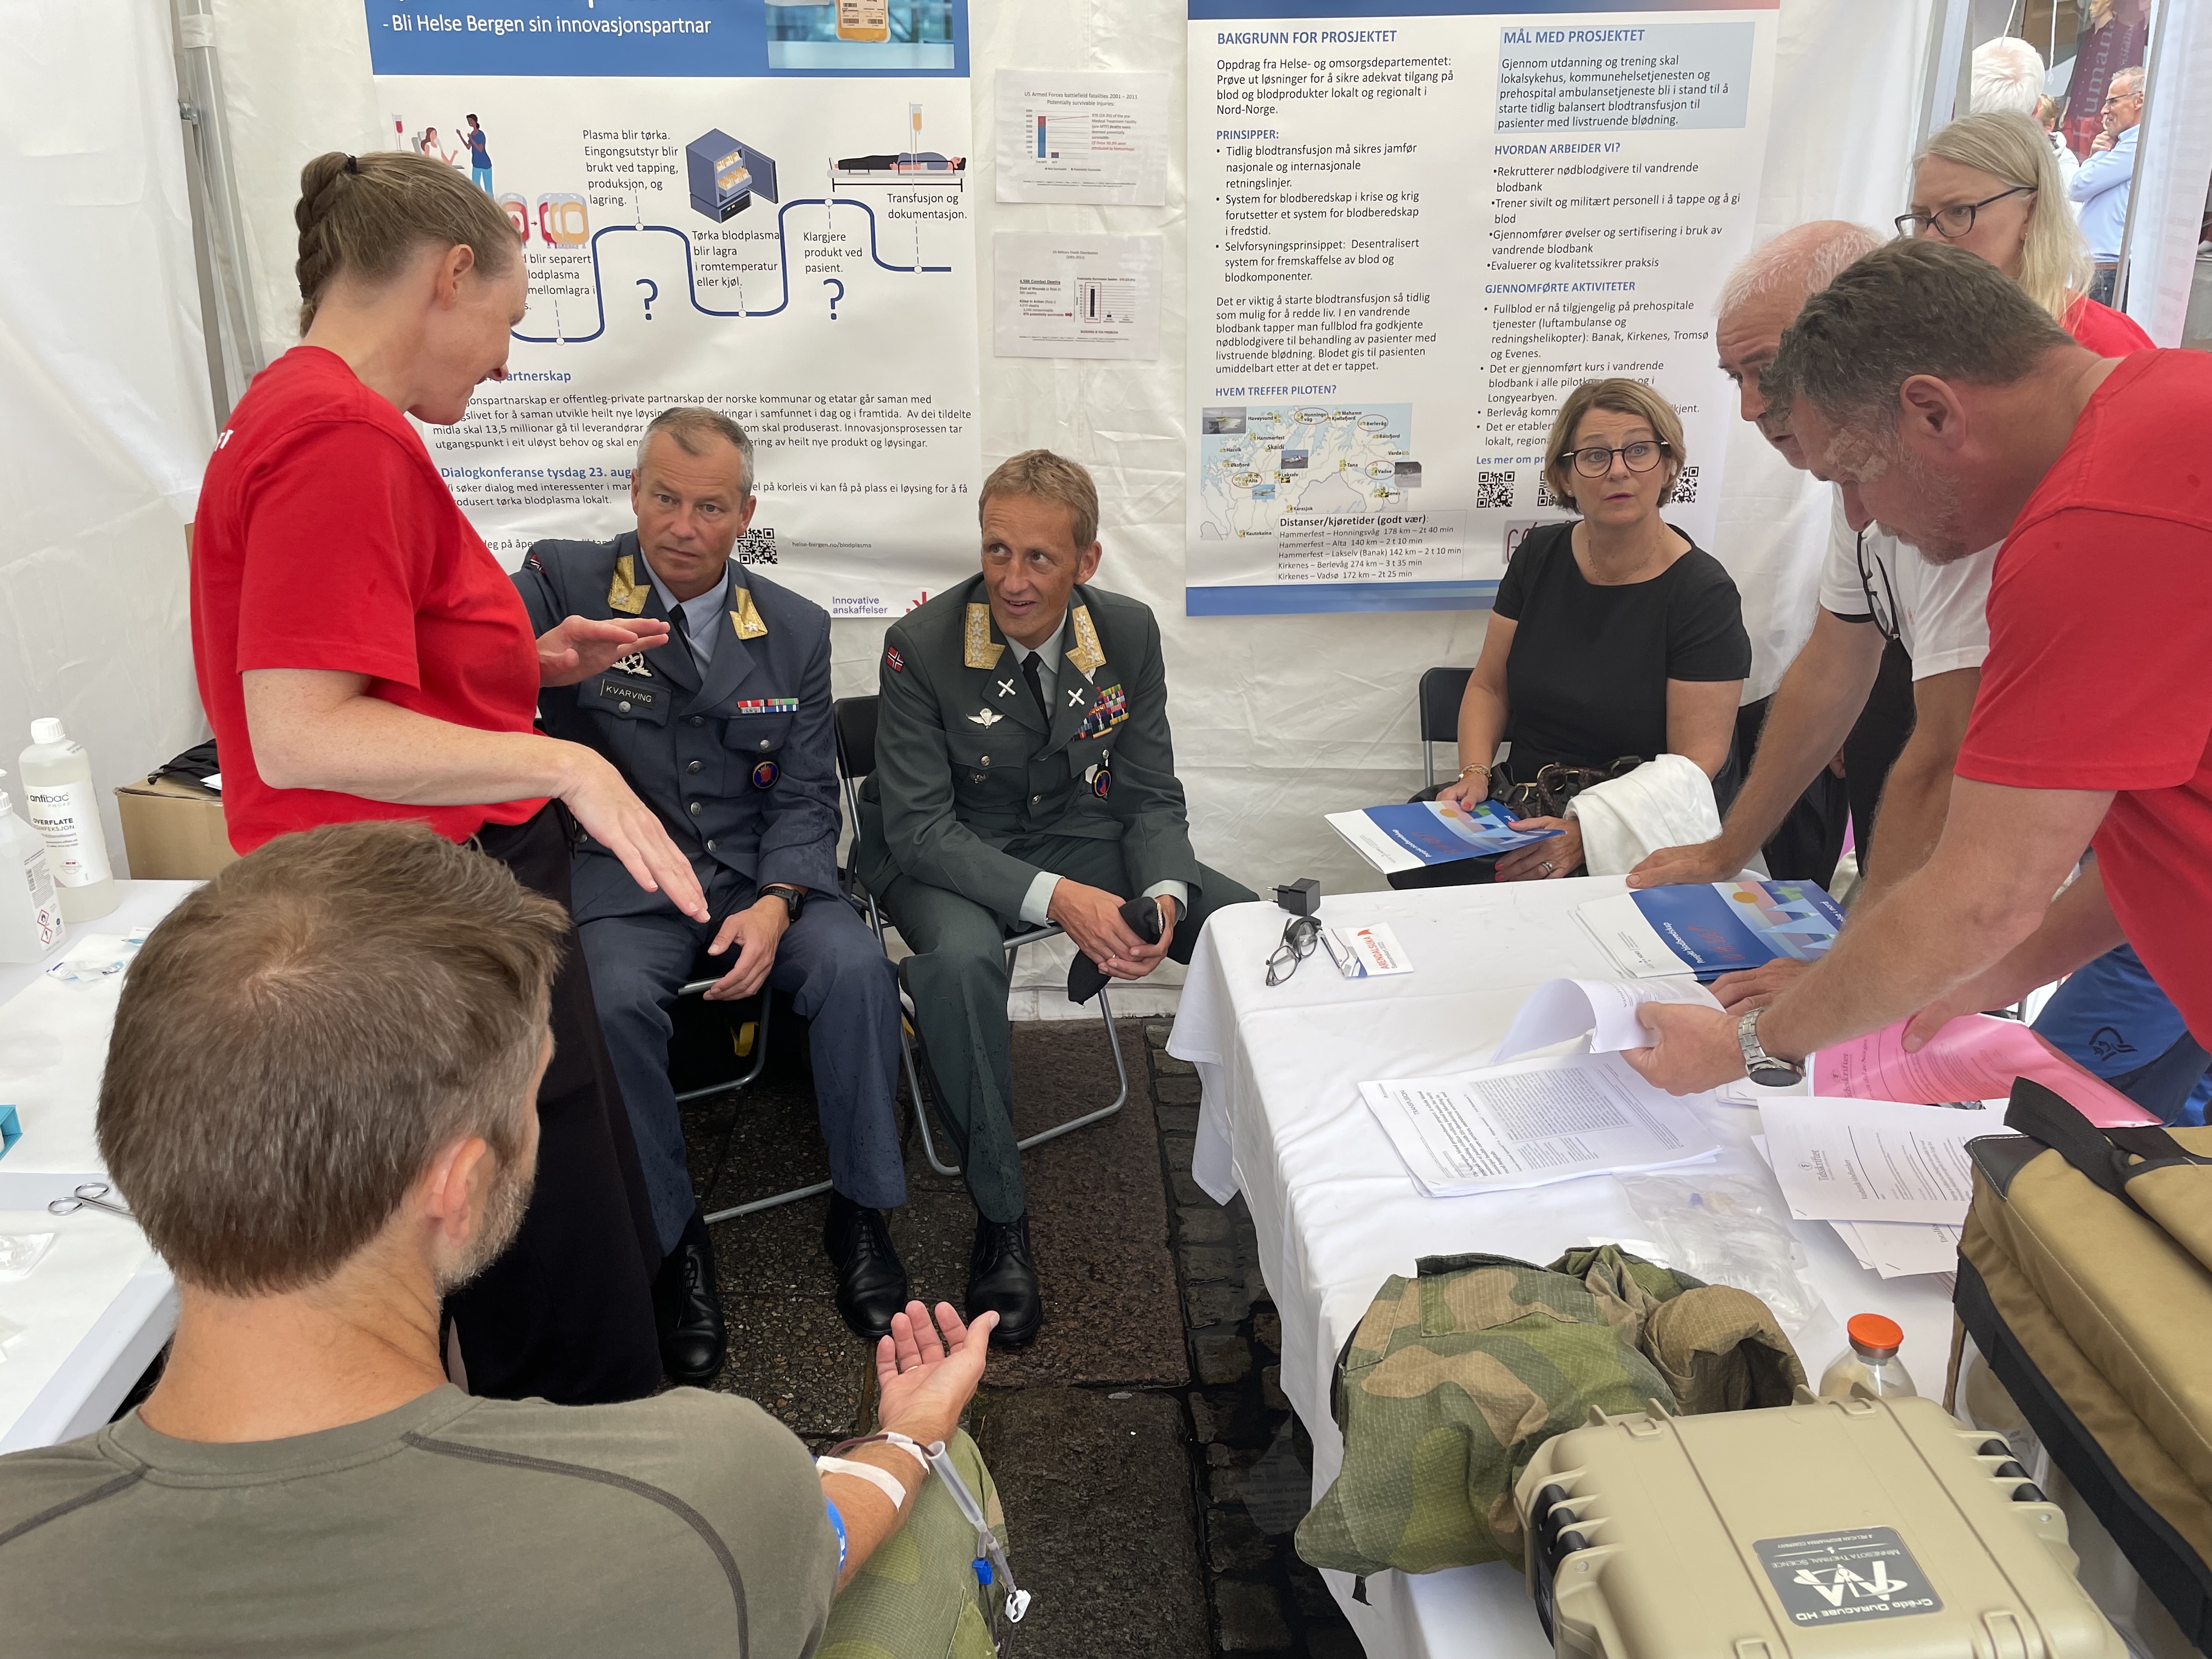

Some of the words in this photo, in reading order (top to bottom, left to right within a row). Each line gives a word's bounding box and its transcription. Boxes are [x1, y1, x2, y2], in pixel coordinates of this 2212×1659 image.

[392, 14, 412, 31] Bli
[417, 14, 462, 31] Helse
[466, 15, 524, 36] Bergen
[529, 15, 552, 32] sin
[556, 15, 712, 37] innovasjonspartnar
[1218, 32, 1288, 44] BAKGRUNN
[1293, 32, 1317, 43] FOR
[1322, 30, 1397, 43] PROSJEKTET
[1504, 29, 1532, 44] MÅL
[1536, 31, 1565, 43] MED
[1568, 30, 1645, 43] PROSJEKTET
[1217, 59, 1261, 72] Oppdrag
[1263, 58, 1276, 69] fra
[1280, 58, 1311, 69] Helse-
[1314, 60, 1326, 70] og
[1329, 57, 1451, 70] omsorgsdepartementet:
[1502, 59, 1547, 71] Gjennom
[1551, 57, 1602, 69] utdanning
[1605, 59, 1618, 69] og
[1621, 56, 1657, 68] trening
[1659, 55, 1679, 65] skal
[1217, 104, 1278, 116] Nord-Norge.
[583, 129, 619, 139] Plasma
[622, 129, 638, 139] blir
[641, 129, 670, 140] tørka.
[1217, 129, 1279, 140] PRINSIPPER:
[585, 146, 659, 158] Eingongsutstyr
[662, 146, 678, 156] blir
[1494, 144, 1547, 155] HVORDAN
[1549, 143, 1601, 154] ARBEIDER
[1604, 142, 1621, 153] VI?
[586, 162, 613, 172] brukt
[616, 162, 634, 172] ved
[636, 163, 678, 174] tapping,
[588, 178, 647, 191] produksjon,
[651, 181, 663, 191] og
[589, 194, 627, 206] lagring.
[887, 193, 944, 205] Transfusjon
[946, 196, 958, 205] og
[888, 208, 967, 221] dokumentasjon.
[691, 230, 719, 241] Tørka
[722, 229, 780, 241] blodplasma
[803, 232, 846, 244] Klargjere
[1225, 240, 1345, 252] Selvforsyningsprinsippet:
[1352, 238, 1419, 249] Desentralisert
[1492, 244, 1544, 255] vandrende
[1547, 243, 1593, 253] blodbank
[693, 246, 710, 256] blir
[713, 246, 737, 258] lagra
[804, 247, 843, 259] produkt
[845, 247, 862, 257] ved
[530, 253, 546, 263] blir
[549, 254, 591, 265] separert
[695, 262, 698, 271] i
[701, 262, 778, 273] romtemperatur
[805, 263, 843, 274] pasient.
[527, 269, 579, 281] lodplasma
[1225, 272, 1312, 283] blodkomponenter.
[697, 276, 719, 286] eller
[722, 276, 742, 289] kjøl.
[1485, 282, 1569, 294] GJENNOMFØRTE
[1571, 281, 1635, 292] AKTIVITETER
[592, 286, 596, 295] i
[636, 279, 658, 320] ?
[823, 278, 844, 320] ?
[1492, 332, 1589, 345] redningshelikopter):
[1592, 331, 1624, 342] Banak,
[1627, 331, 1670, 341] Kirkenes,
[1673, 331, 1708, 340] Tromsø
[1491, 351, 1503, 360] og
[1505, 349, 1541, 358] Evenes.
[1216, 387, 1245, 396] HVEM
[1248, 386, 1288, 396] TREFFER
[1291, 385, 1336, 395] PILOTEN?
[1488, 393, 1557, 404] Longyearbyen.
[1477, 456, 1491, 464] Les
[441, 466, 544, 481] Dialogkonferanse
[546, 467, 586, 479] tysdag
[589, 467, 607, 477] 23.
[1280, 516, 1375, 527] Distanser/kjøretider
[1378, 515, 1402, 526] (godt
[1404, 514, 1428, 524] vær):
[1279, 530, 1325, 538] Hammerfest
[1333, 528, 1380, 537] Honningsvåg
[833, 596, 879, 605] Innovative
[833, 605, 888, 614] anskaffelser
[606, 685, 652, 703] KVARVING
[30, 794, 69, 803] antibac
[1363, 936, 1390, 969] ARENDALSUKA
[1400, 1090, 1420, 1115] TRANSFUSION
[1809, 1554, 1850, 1564] THERMAL
[1849, 1549, 1900, 1560] MINNESOTA
[1771, 1559, 1809, 1568] SCIENCE
[1820, 1603, 1890, 1617] DURACUBE
[1796, 1612, 1819, 1621] HD
